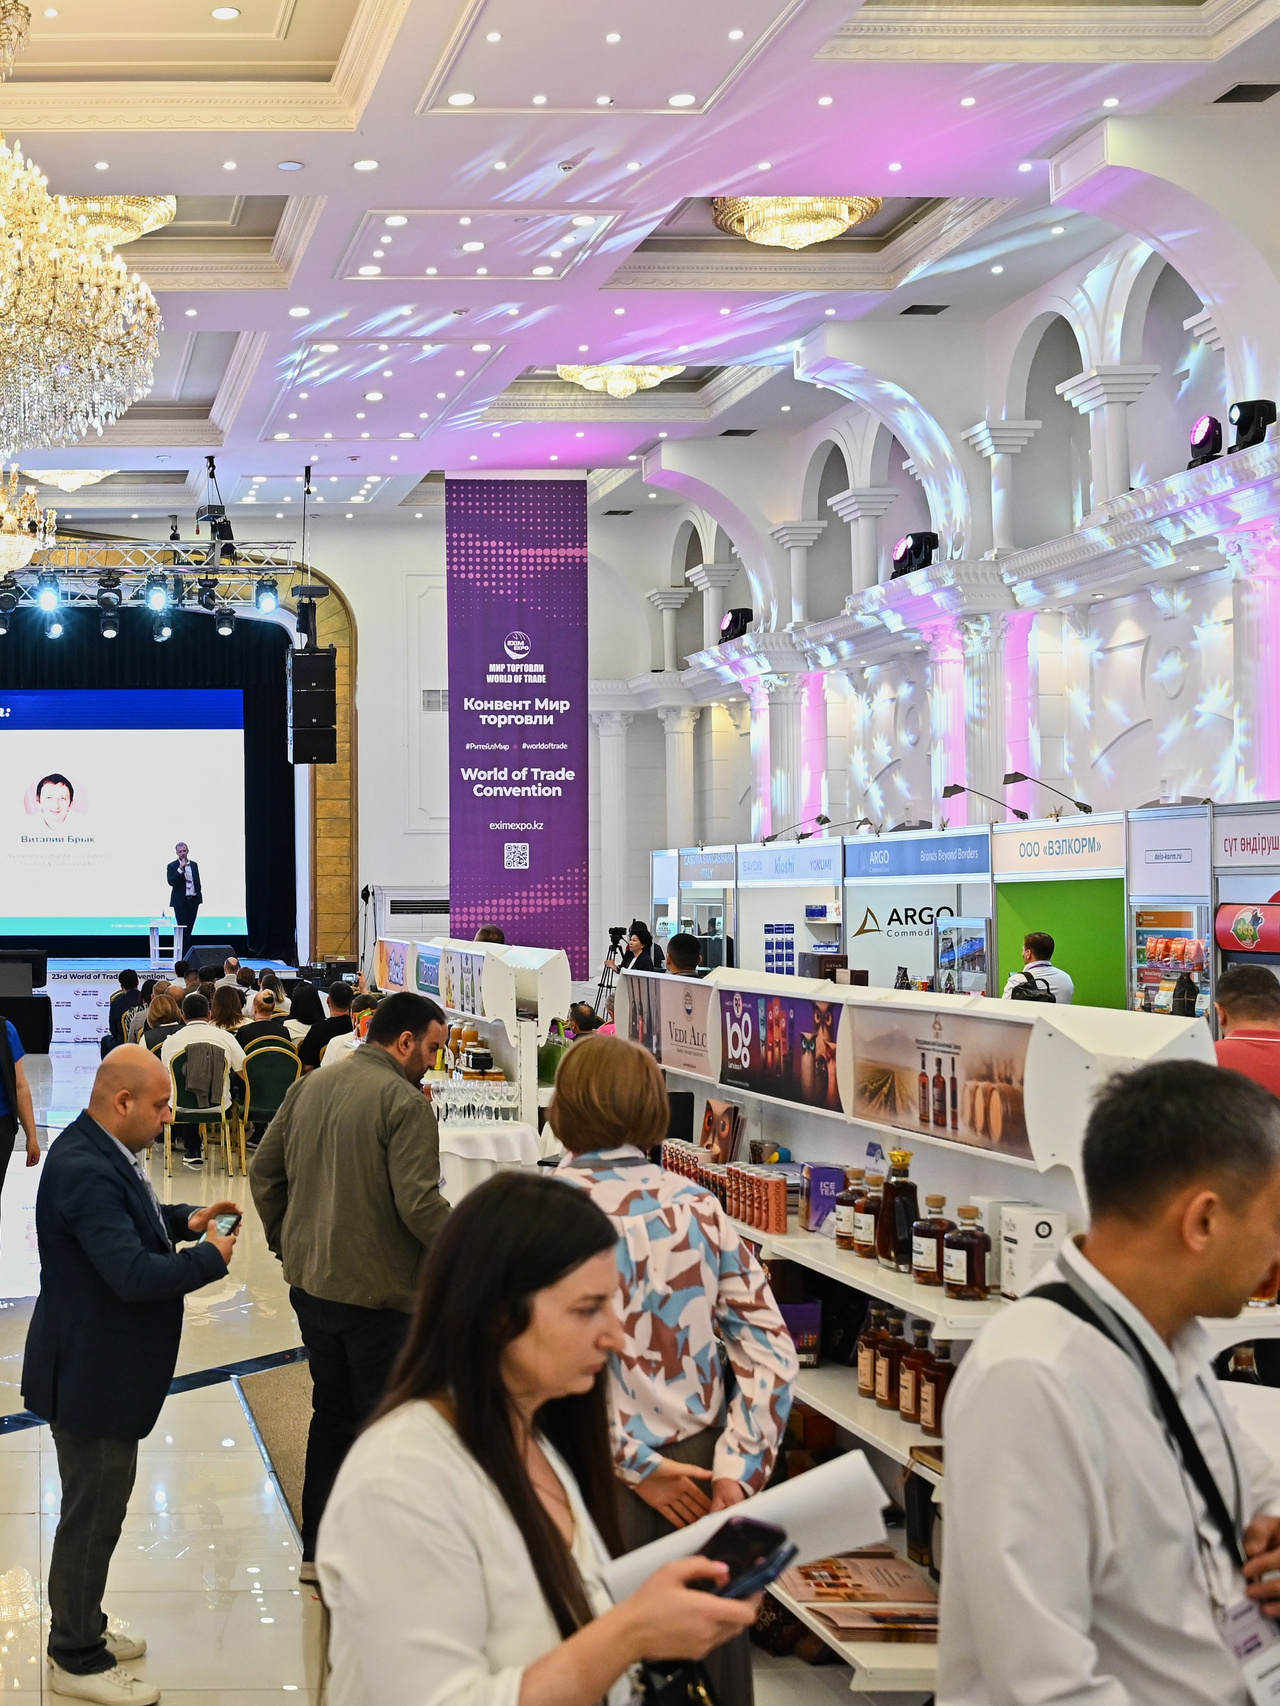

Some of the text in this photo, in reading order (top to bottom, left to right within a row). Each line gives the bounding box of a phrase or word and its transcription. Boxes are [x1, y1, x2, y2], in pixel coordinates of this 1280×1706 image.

[489, 664, 544, 672] МИР ТОРГОВЛИ
[486, 674, 547, 683] WORLD OF TRADE
[463, 698, 570, 713] Конвент Мир
[479, 714, 554, 728] торговли
[465, 743, 509, 751] #РитейлМир
[522, 742, 568, 750] #worldoftrade
[460, 767, 575, 781] World of Trade
[473, 783, 562, 797] Convention
[489, 820, 544, 832] eximexpo.kz
[67, 835, 95, 844] Брык
[920, 847, 978, 862] Brands Beyond Borders
[1019, 837, 1102, 858] ООО «ВЭЛКОРМ»
[1224, 838, 1238, 857] сүт
[869, 850, 890, 864] ARGO
[774, 856, 795, 874] kioshi
[810, 859, 832, 870] YOKUMI
[668, 1021, 707, 1048] VEDI ALC
[820, 1181, 835, 1189] ICE
[774, 1182, 782, 1232] cappuccino
